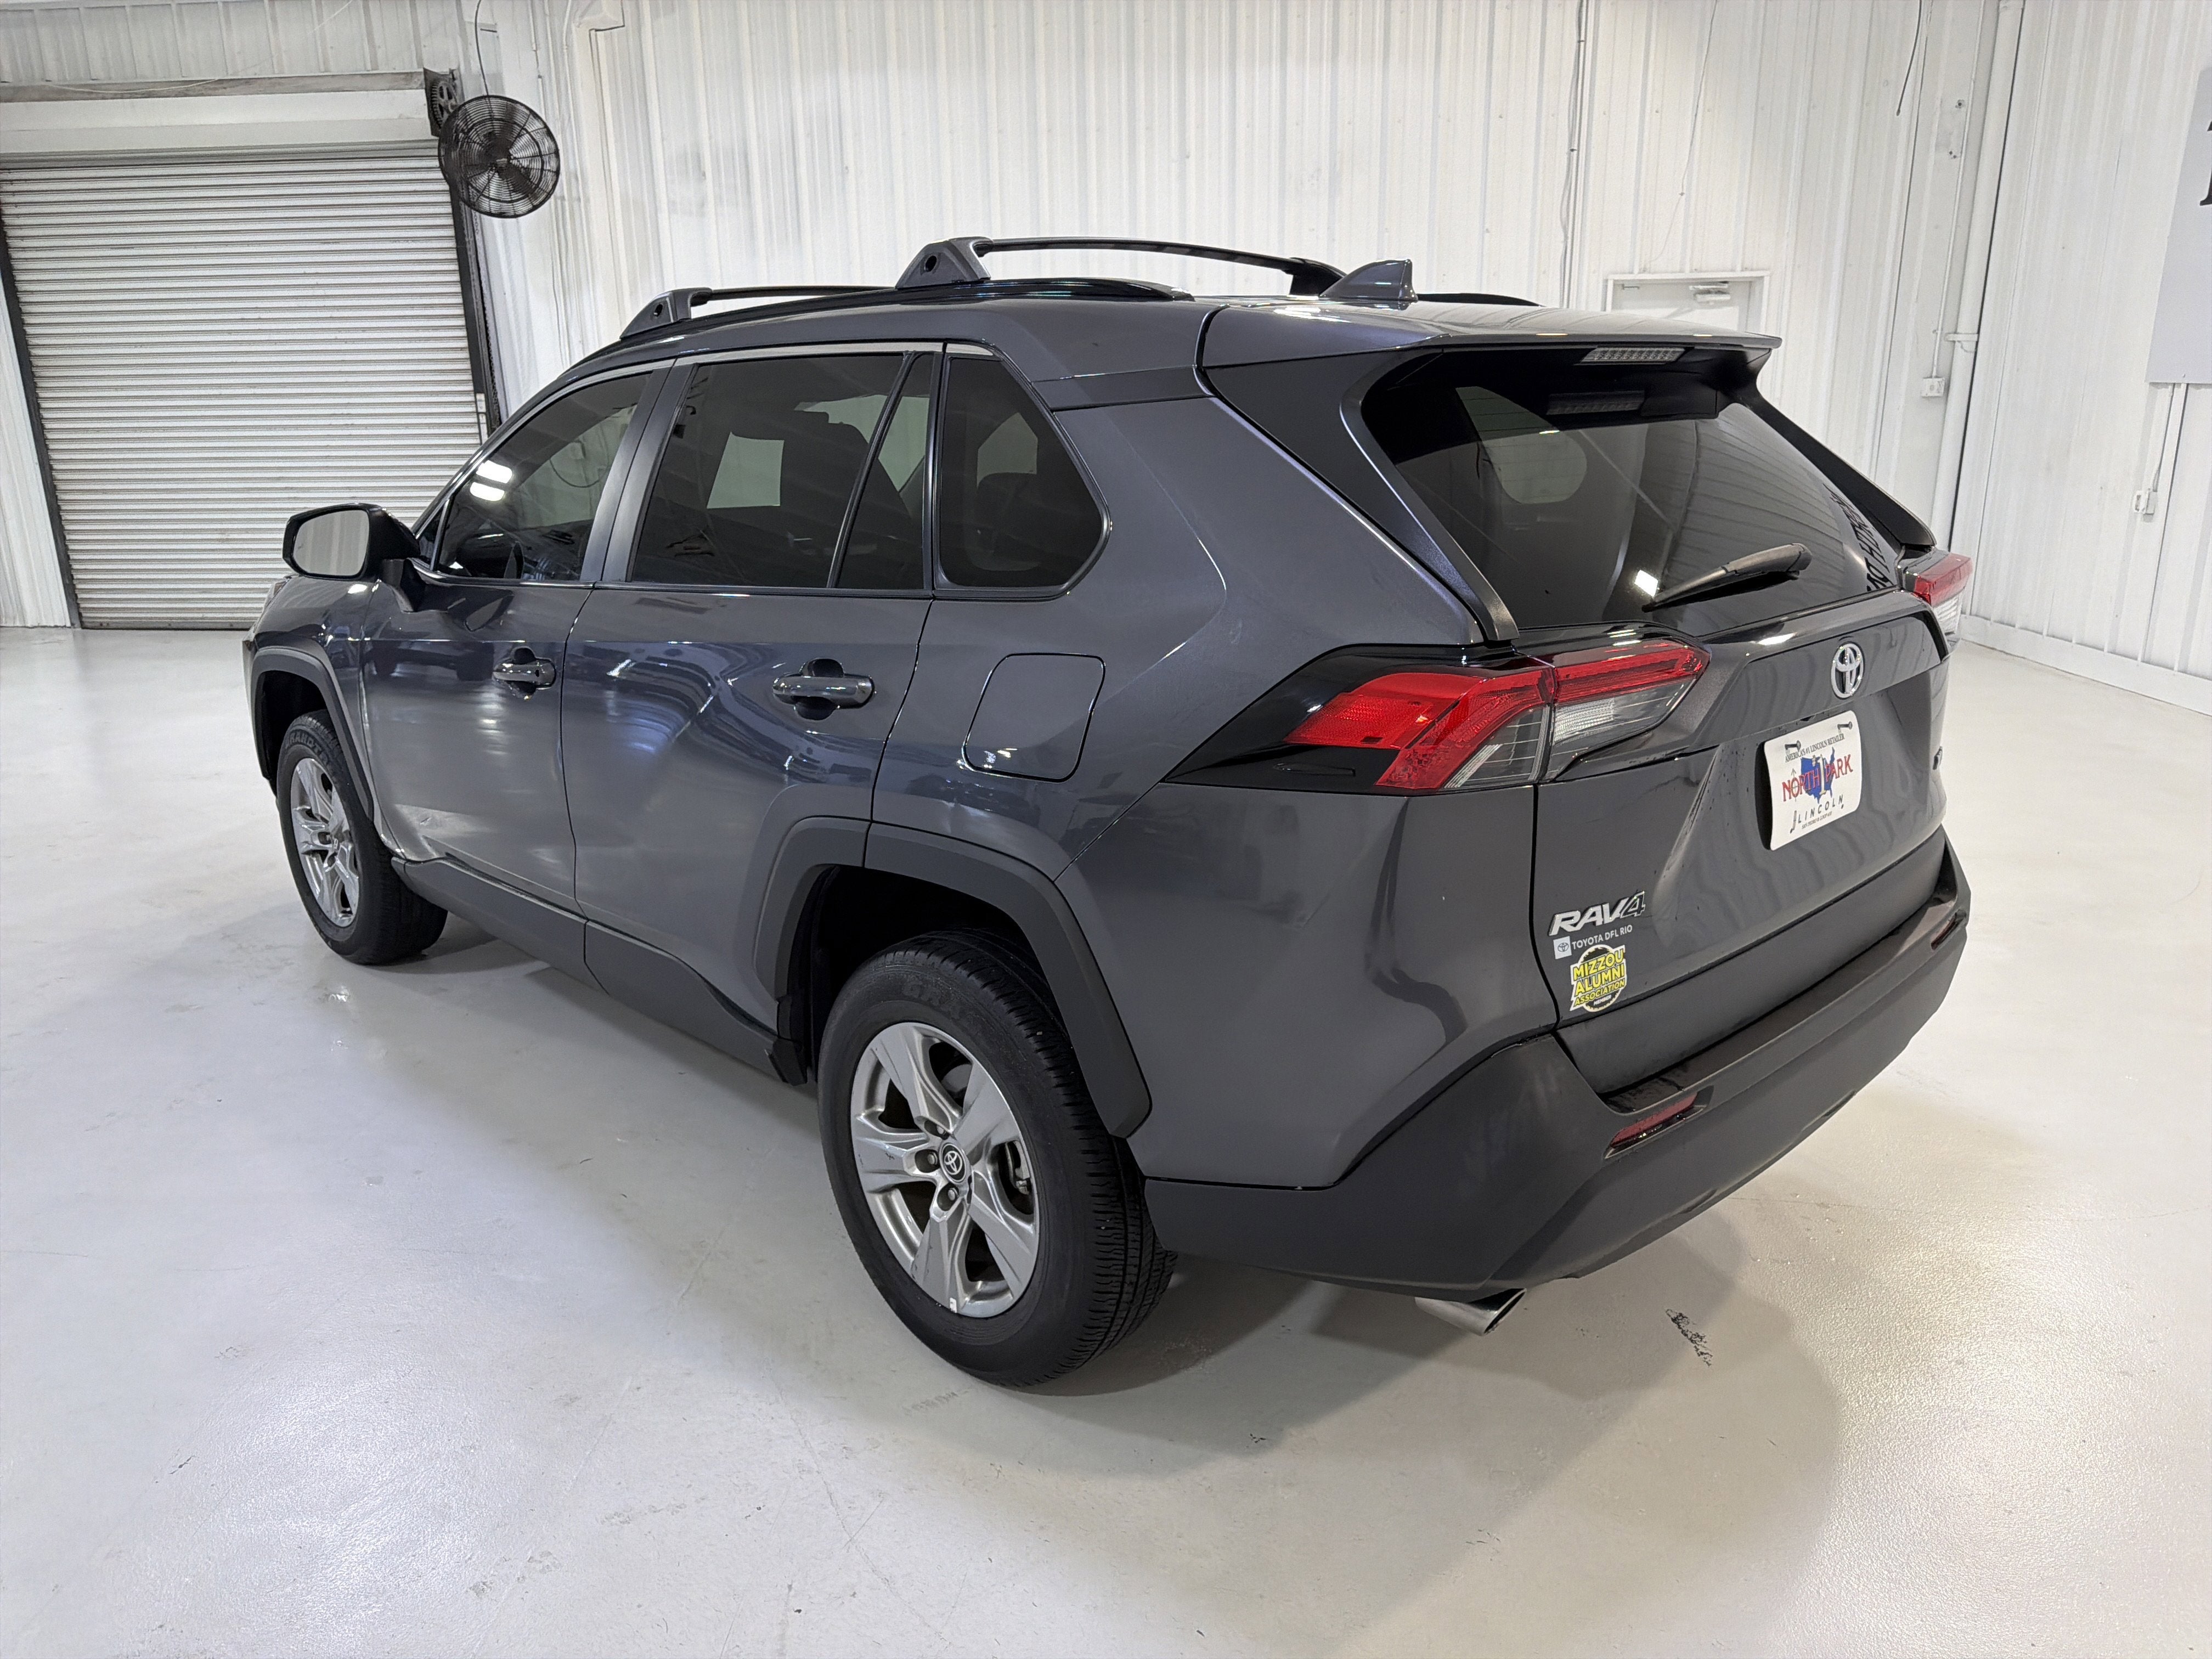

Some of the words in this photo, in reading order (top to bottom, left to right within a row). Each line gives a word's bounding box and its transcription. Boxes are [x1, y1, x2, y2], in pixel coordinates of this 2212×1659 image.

[1810, 741, 1828, 752] LINCOLN
[1827, 733, 1845, 746] RETAILER
[1782, 768, 1820, 802] NORTH
[1825, 754, 1853, 783] PARK
[1798, 794, 1843, 823] LINCOLN
[1548, 890, 1646, 936] RAV4
[1571, 934, 1604, 950] TOYOTA
[1620, 924, 1633, 936] RIO
[1573, 949, 1624, 981] MIZZOU
[1575, 963, 1625, 997] ALUMNI
[1573, 979, 1625, 1007] ASSOCIATION
